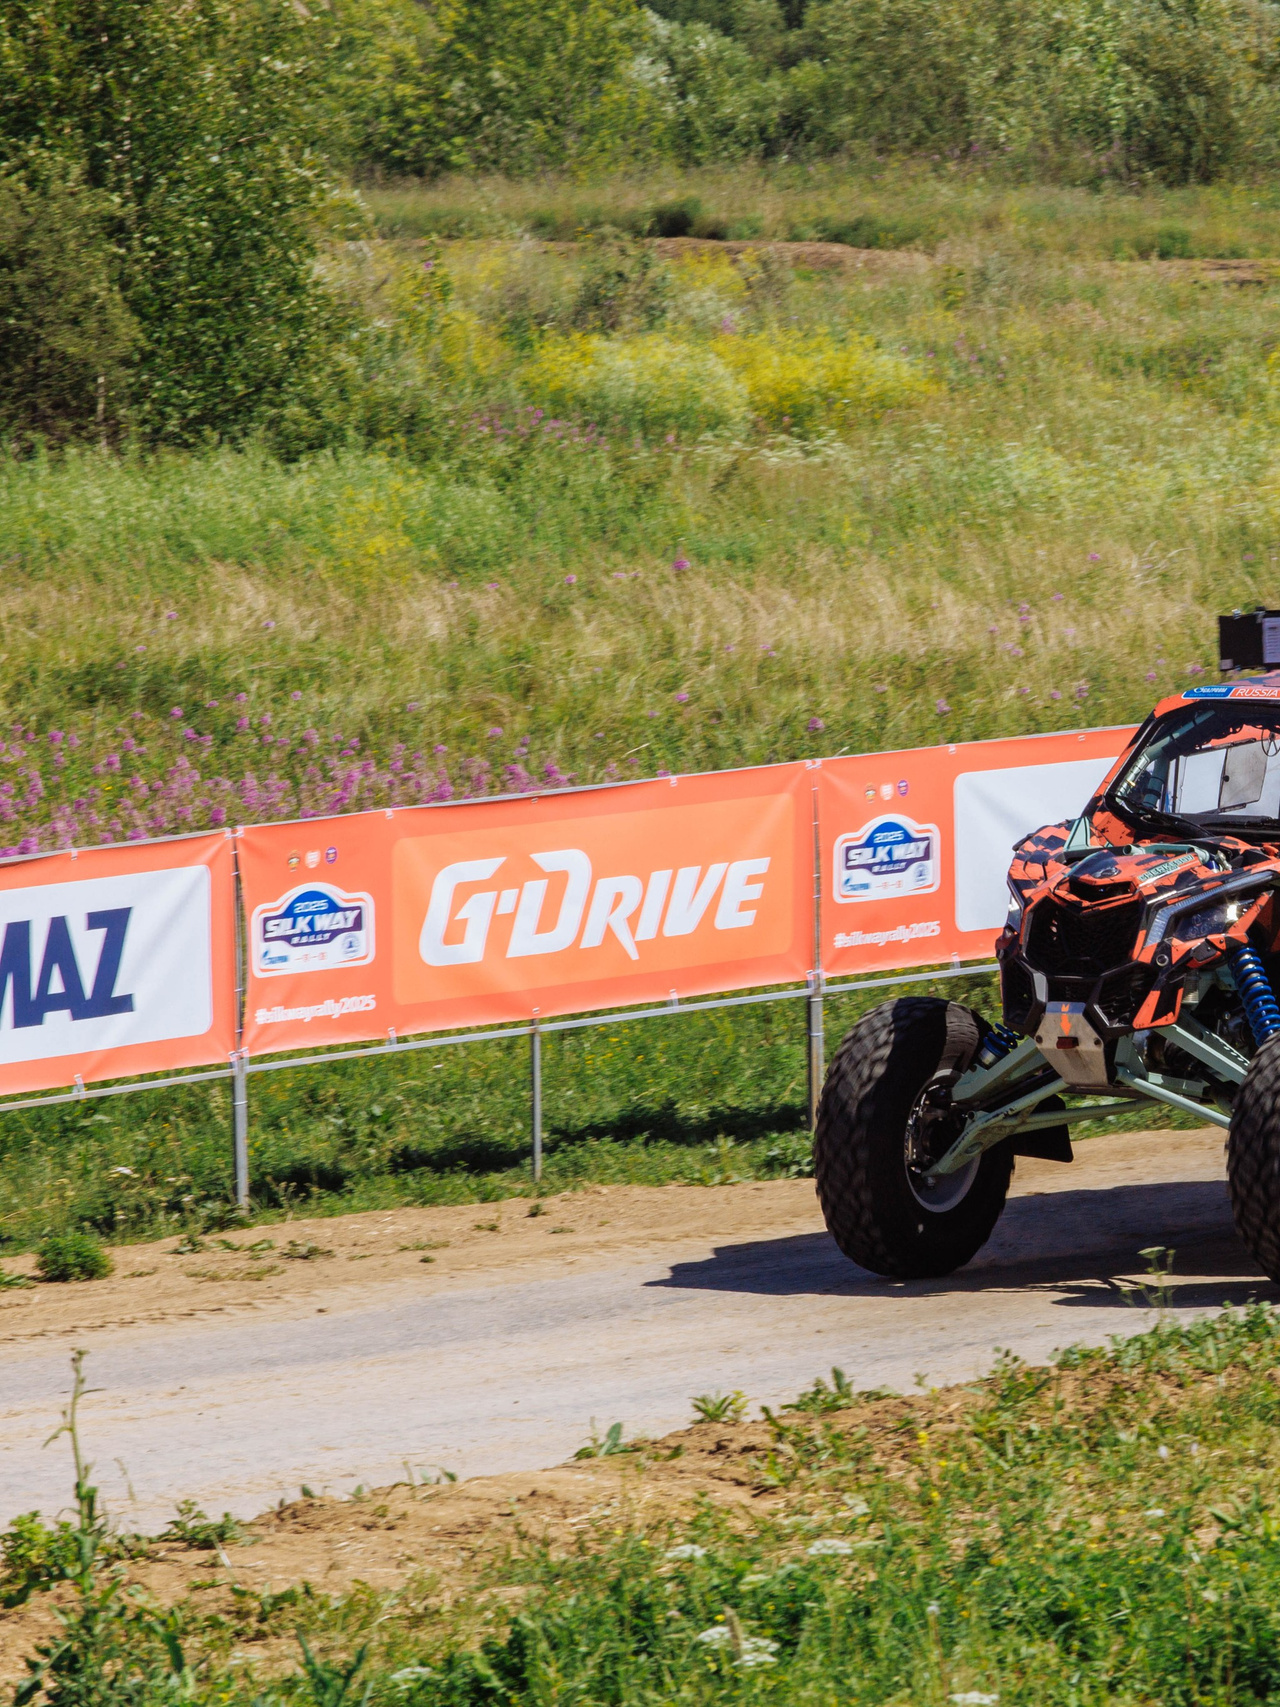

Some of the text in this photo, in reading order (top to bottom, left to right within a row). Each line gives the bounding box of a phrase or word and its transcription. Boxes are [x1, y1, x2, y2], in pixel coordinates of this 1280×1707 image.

[1235, 688, 1278, 697] RUSSIA
[873, 830, 905, 843] 2025
[846, 841, 930, 867] SILK WAY
[871, 862, 907, 873] RALLY
[293, 899, 329, 914] 2025
[419, 848, 771, 966] G-DRIVE
[264, 910, 361, 939] SILK WAY
[833, 920, 941, 948] #silkwayrally2025
[290, 932, 332, 945] RALLY
[255, 994, 377, 1025] #silkwayrally2025
